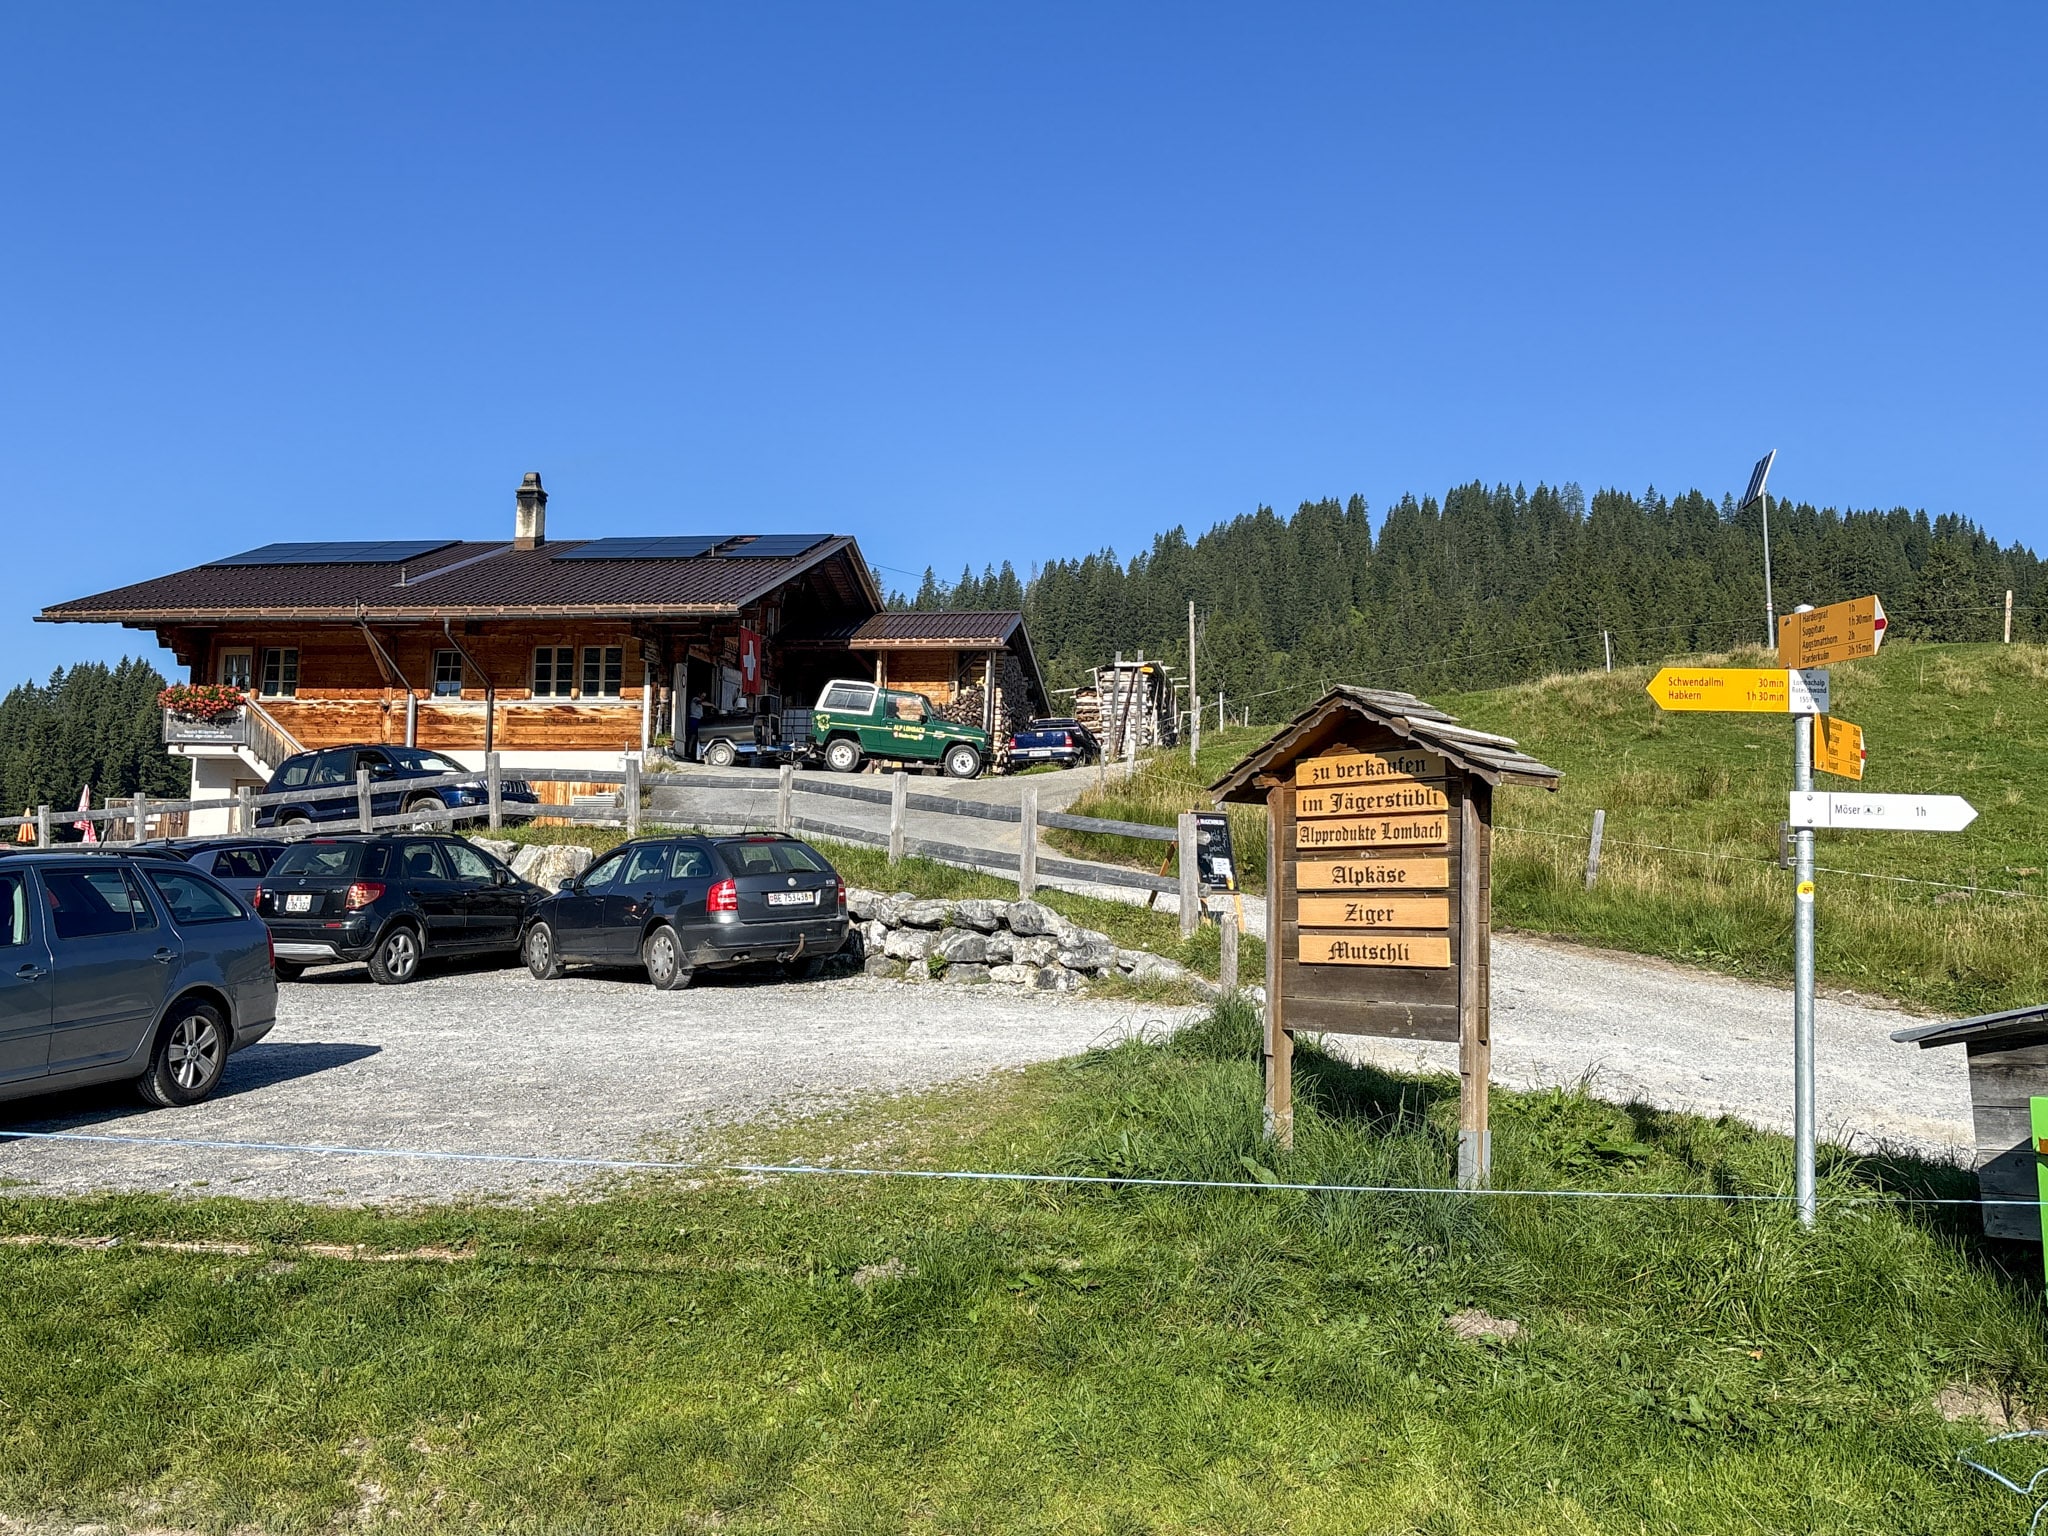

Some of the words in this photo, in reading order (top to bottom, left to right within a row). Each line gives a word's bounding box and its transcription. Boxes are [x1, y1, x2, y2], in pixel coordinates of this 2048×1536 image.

[1668, 676, 1724, 687] Schwendallmi
[1668, 690, 1702, 700] Habkern
[1312, 766, 1330, 783] zu
[1336, 756, 1426, 779] verkaufen
[1302, 796, 1323, 812] im
[1330, 789, 1438, 813] Jägerstübli
[1835, 804, 1860, 815] Möser
[1299, 825, 1377, 846] Alpprodukte
[1381, 821, 1442, 842] Lombach
[1331, 865, 1406, 886] Alpkäse
[1344, 903, 1394, 925] Ziger
[1327, 941, 1410, 963] Mutschli
